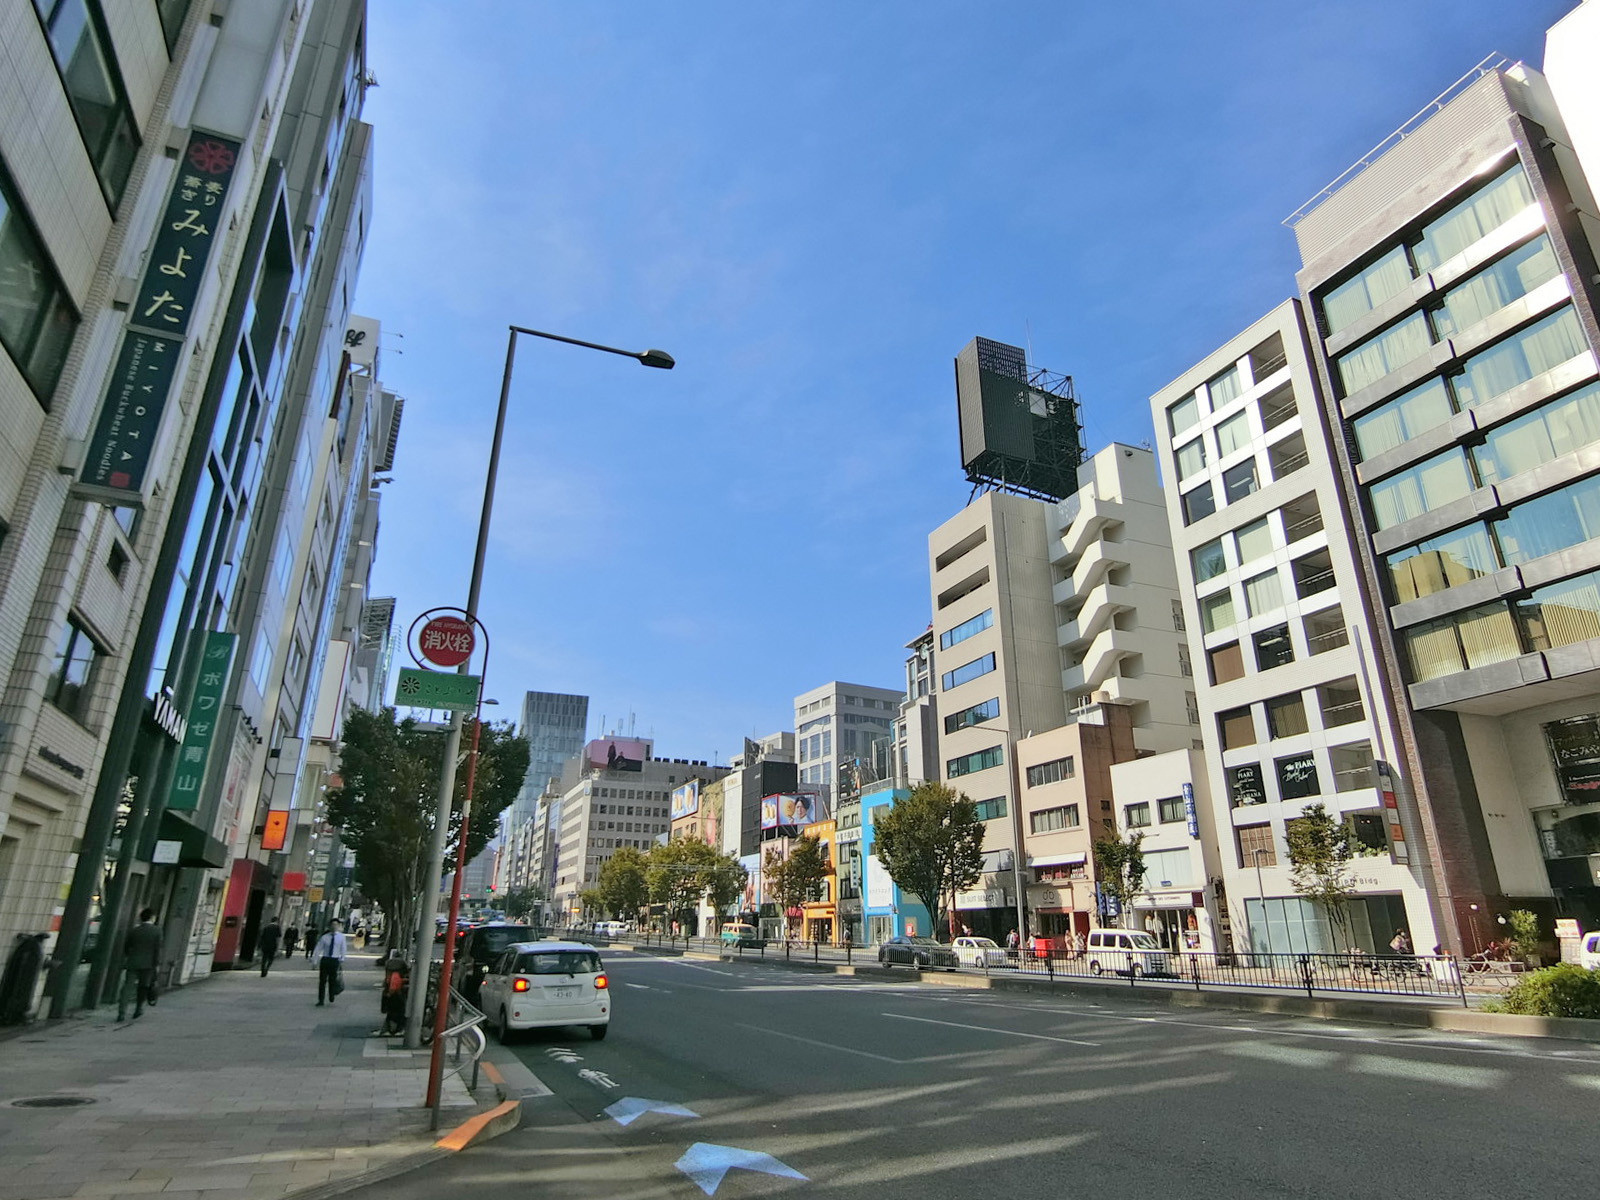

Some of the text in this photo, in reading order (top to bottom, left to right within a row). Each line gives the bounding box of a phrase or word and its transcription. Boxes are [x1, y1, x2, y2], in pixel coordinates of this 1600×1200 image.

[145, 210, 209, 324] みよた
[96, 338, 148, 480] Japanese Buckwheat Noodles
[121, 341, 166, 461] MIYOTA
[424, 630, 471, 653] 消火栓
